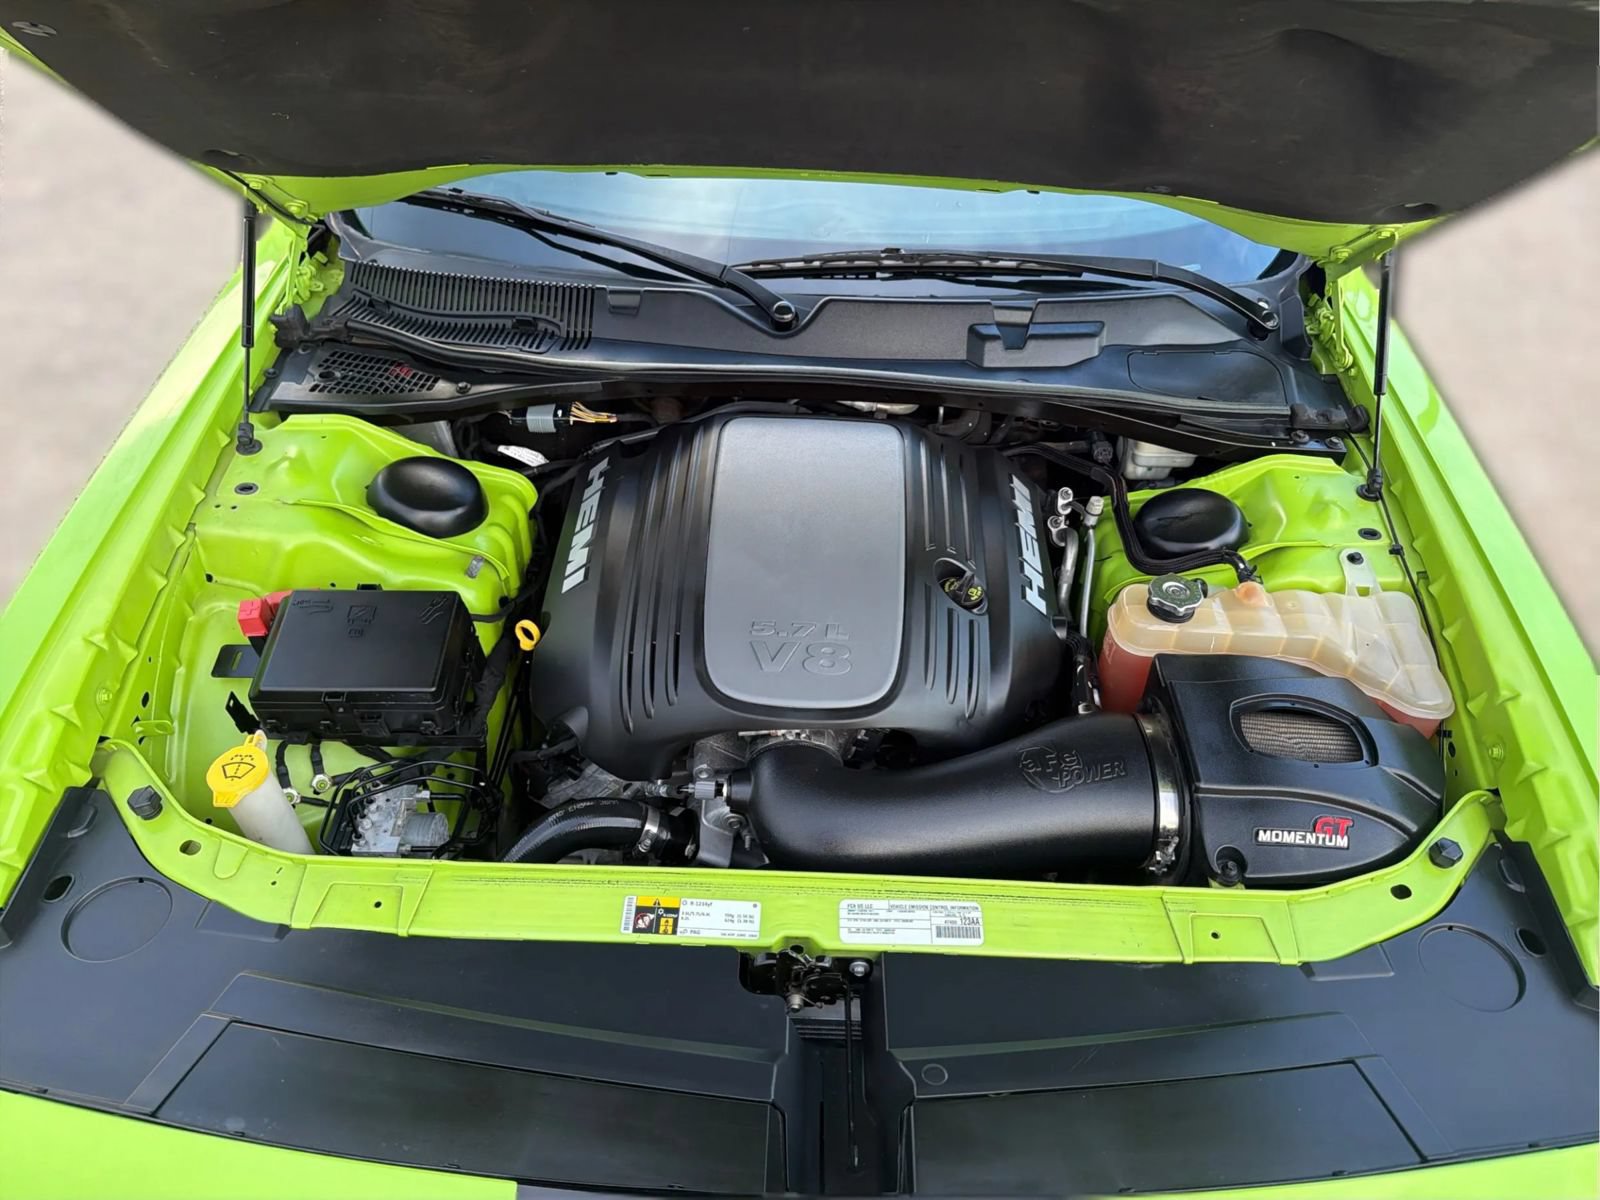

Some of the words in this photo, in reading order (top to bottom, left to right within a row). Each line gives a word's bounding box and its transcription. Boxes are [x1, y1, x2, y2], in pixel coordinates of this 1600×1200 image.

[562, 456, 610, 594] HEMI
[1011, 473, 1047, 616] HEMI
[748, 640, 852, 676] V8
[1058, 760, 1126, 788] POWER
[1257, 829, 1349, 849] MOMENTUM
[1314, 816, 1354, 838] GT
